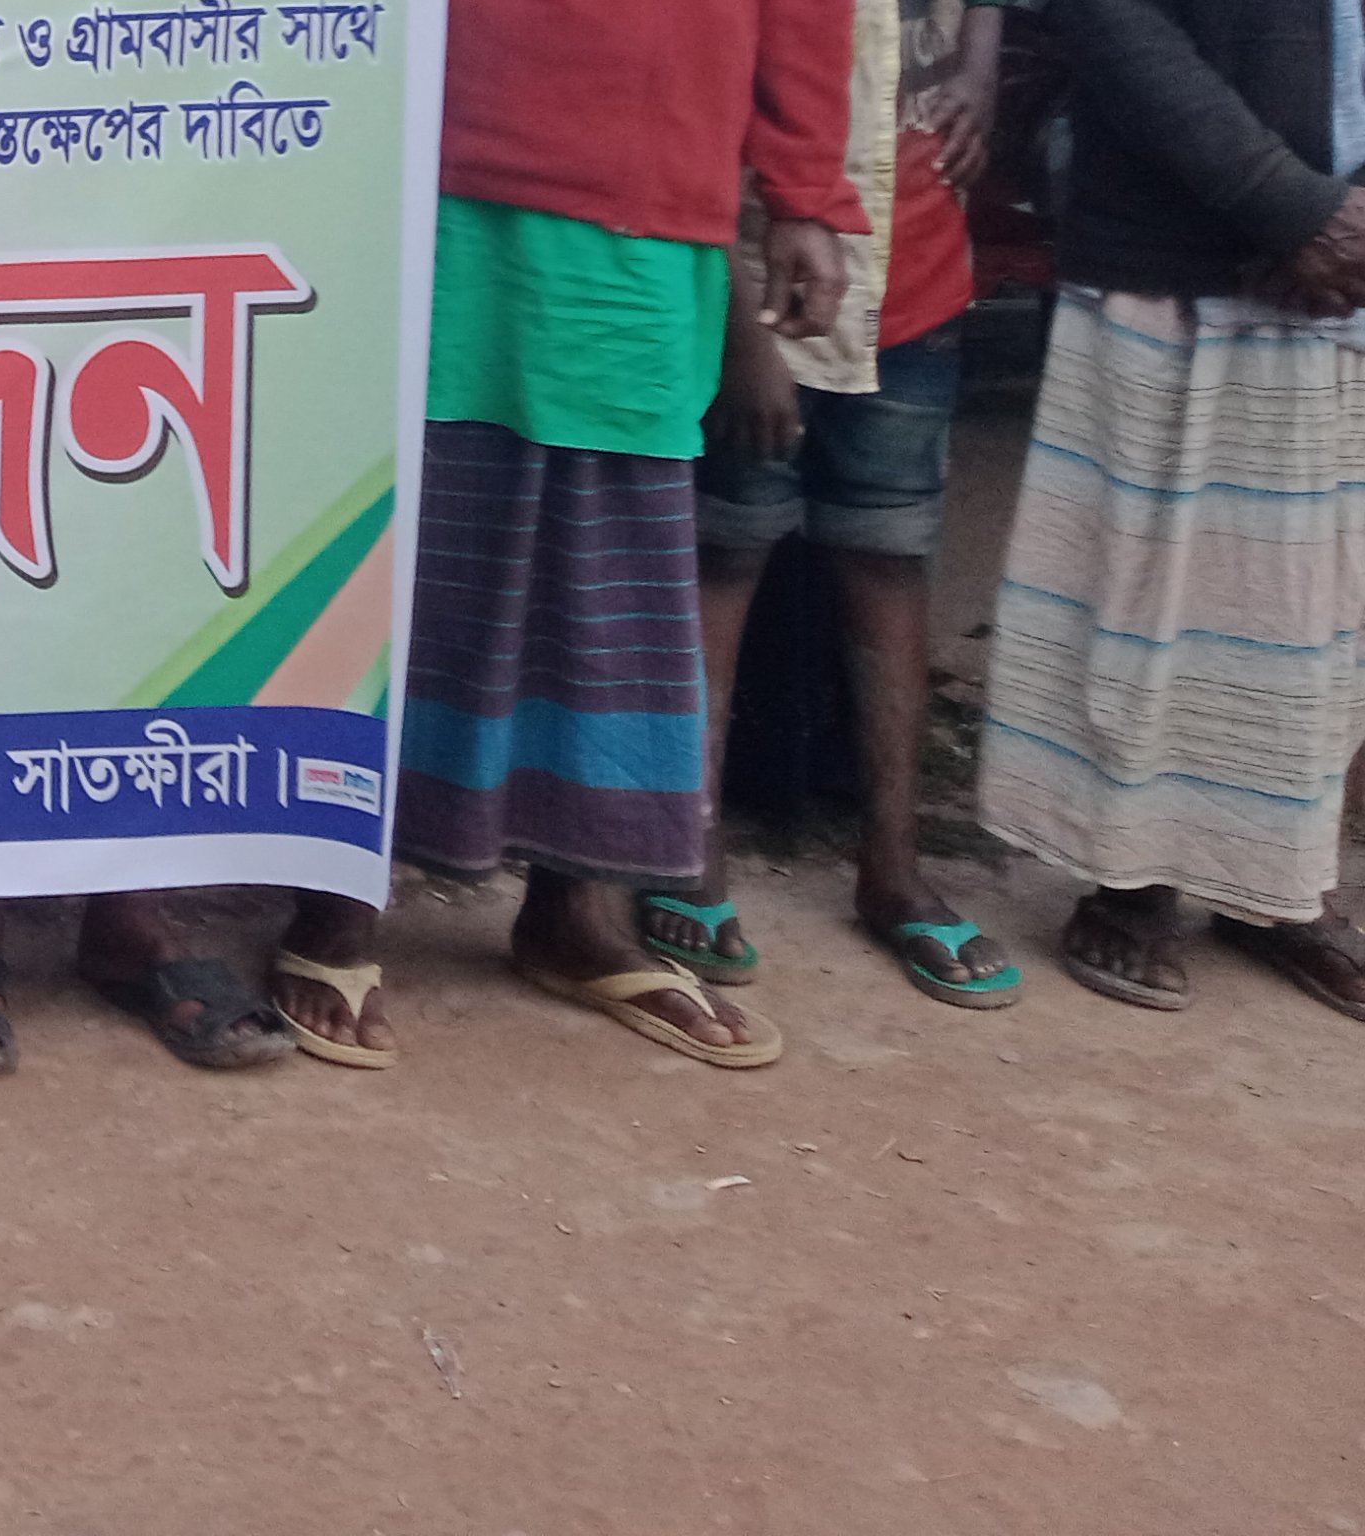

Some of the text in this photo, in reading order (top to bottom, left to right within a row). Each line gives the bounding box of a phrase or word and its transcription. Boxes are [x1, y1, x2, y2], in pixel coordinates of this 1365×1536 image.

[17, 18, 52, 68] ও
[178, 80, 331, 160] দাবিতে
[5, 718, 259, 814] সাতক্ষীরা
